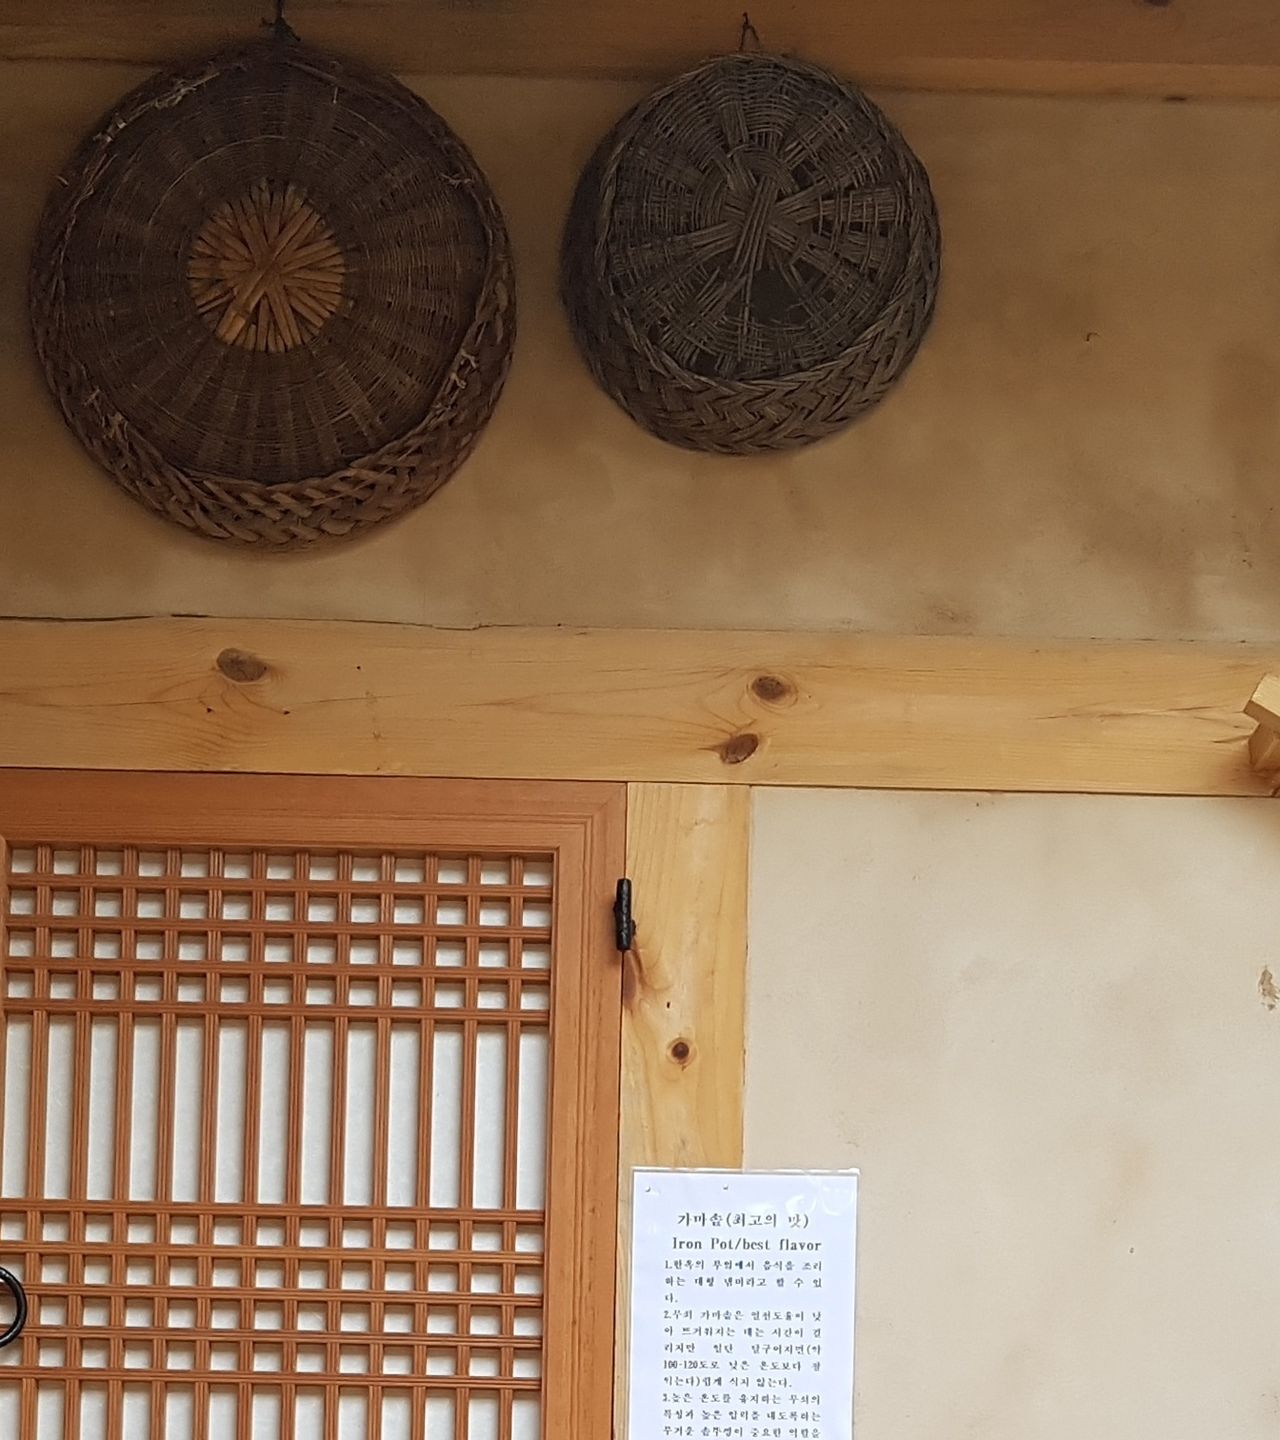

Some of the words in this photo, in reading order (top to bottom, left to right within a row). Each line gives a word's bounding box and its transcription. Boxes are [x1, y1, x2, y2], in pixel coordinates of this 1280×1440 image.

[673, 1237, 702, 1249] Iron
[712, 1238, 769, 1250] Pot/best
[780, 1239, 821, 1250] flavor
[794, 1278, 803, 1288] 수
[665, 1293, 677, 1303] 다.
